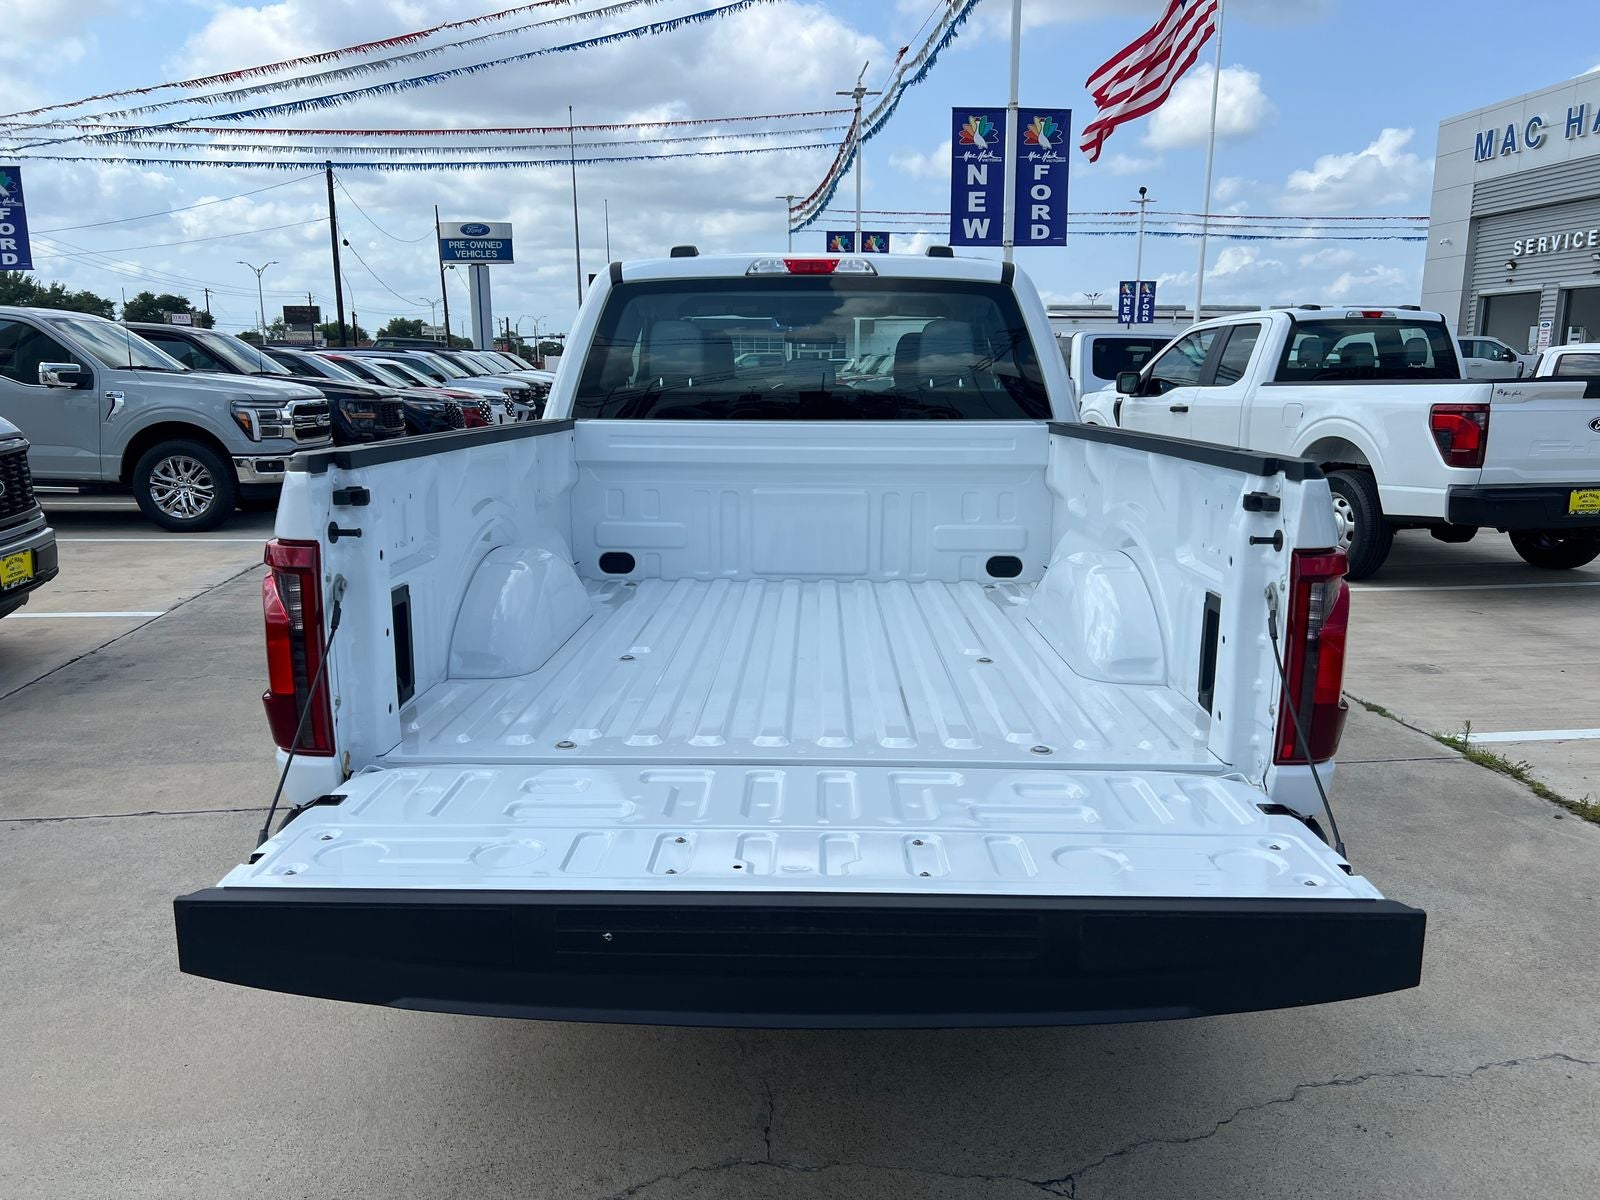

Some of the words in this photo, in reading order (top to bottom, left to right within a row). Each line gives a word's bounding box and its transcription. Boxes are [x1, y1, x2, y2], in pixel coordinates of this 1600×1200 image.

[1474, 116, 1544, 162] MAC
[962, 164, 990, 239] NEW
[1030, 164, 1052, 240] FORD
[0, 208, 18, 265] FORD
[448, 240, 503, 249] PRE-OWNED
[1513, 229, 1598, 256] SERVICE
[455, 250, 498, 258] VEHICLES
[1122, 298, 1131, 321] NEW
[1142, 298, 1150, 321] FORD
